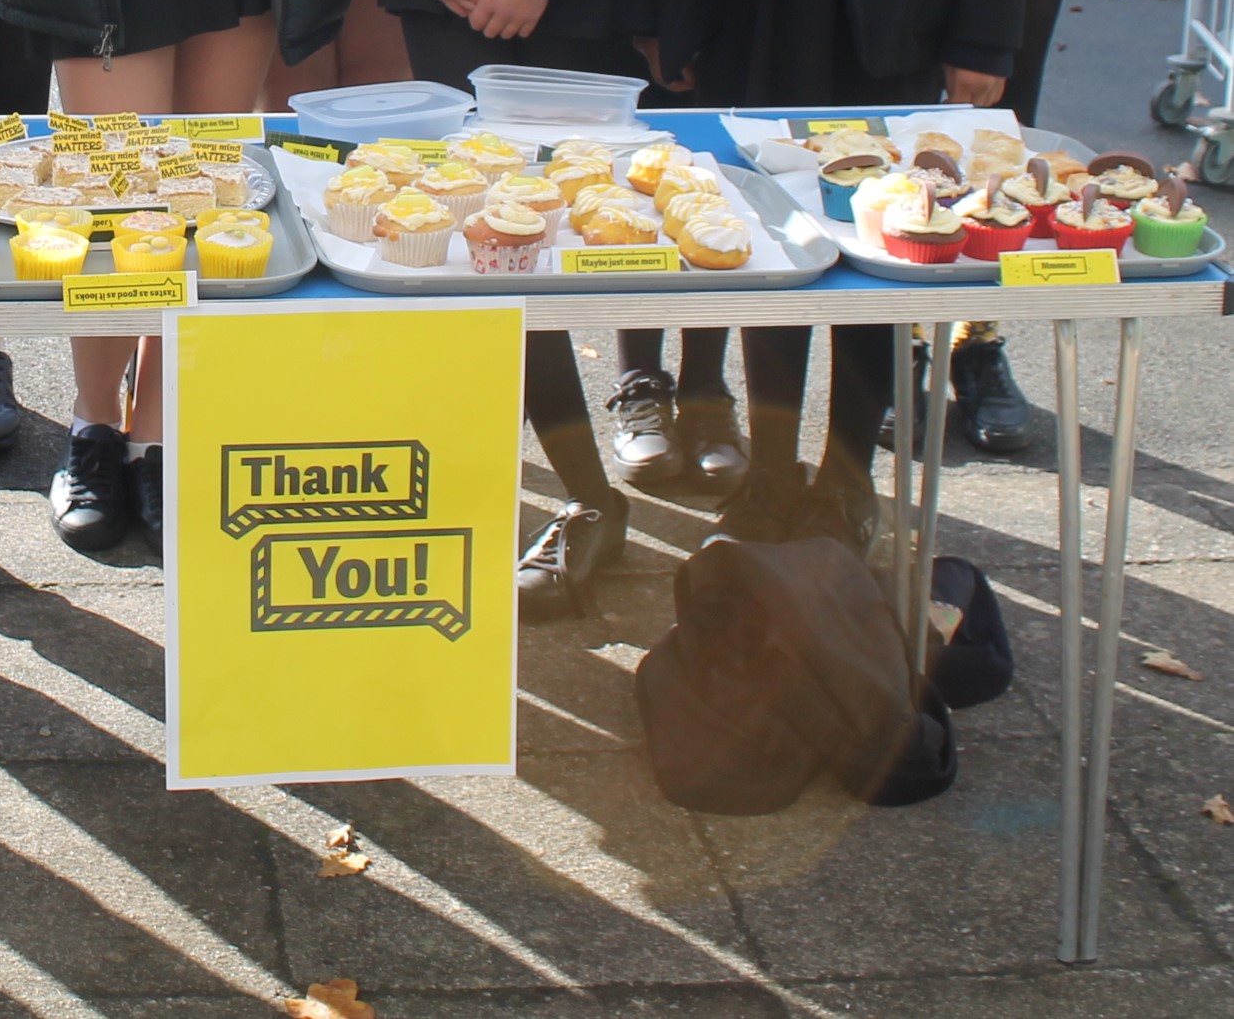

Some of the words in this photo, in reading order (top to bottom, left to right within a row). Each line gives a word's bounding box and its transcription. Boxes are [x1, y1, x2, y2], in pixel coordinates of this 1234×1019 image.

[4, 115, 19, 126] mind
[96, 122, 140, 131] MATTERS
[128, 128, 149, 136] every
[126, 135, 169, 146] MATTERS
[53, 141, 102, 152] MATTERS
[192, 142, 217, 150] every
[118, 151, 139, 159] mind
[91, 161, 141, 173] MATTERS
[158, 159, 178, 167] every
[161, 163, 199, 178] MATTERS
[581, 259, 607, 268] Maybe
[608, 259, 623, 268] just
[75, 291, 98, 301] looks
[99, 291, 106, 300] it
[117, 290, 138, 299] good
[150, 289, 177, 297] Tastes
[240, 453, 389, 497] Thank
[297, 543, 429, 599] You!
